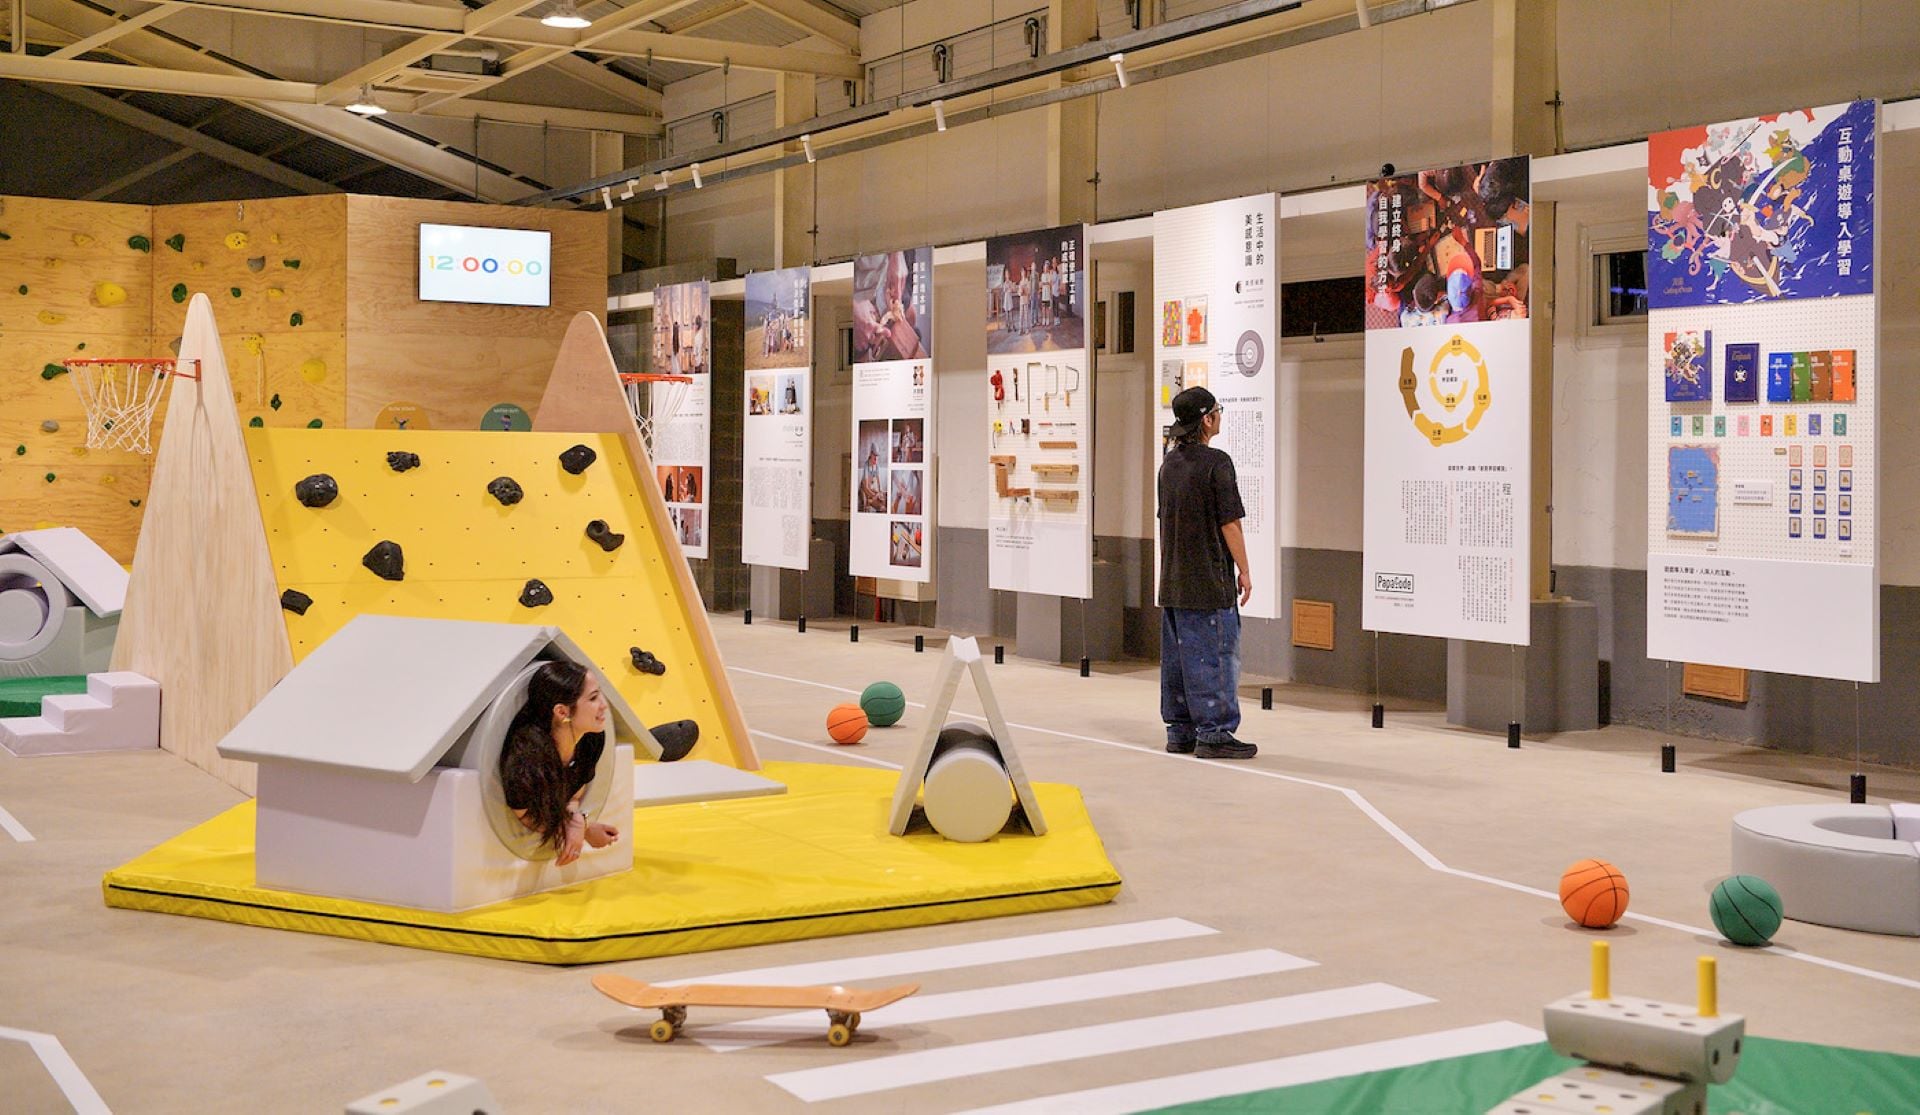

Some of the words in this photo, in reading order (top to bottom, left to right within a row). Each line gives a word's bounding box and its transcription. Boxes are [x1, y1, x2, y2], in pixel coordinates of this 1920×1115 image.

[1391, 194, 1402, 253] 建立終身
[1837, 127, 1854, 276] 互動桌遊導入學習
[428, 255, 542, 276] 12:00:00
[1256, 212, 1264, 266] 生活中的
